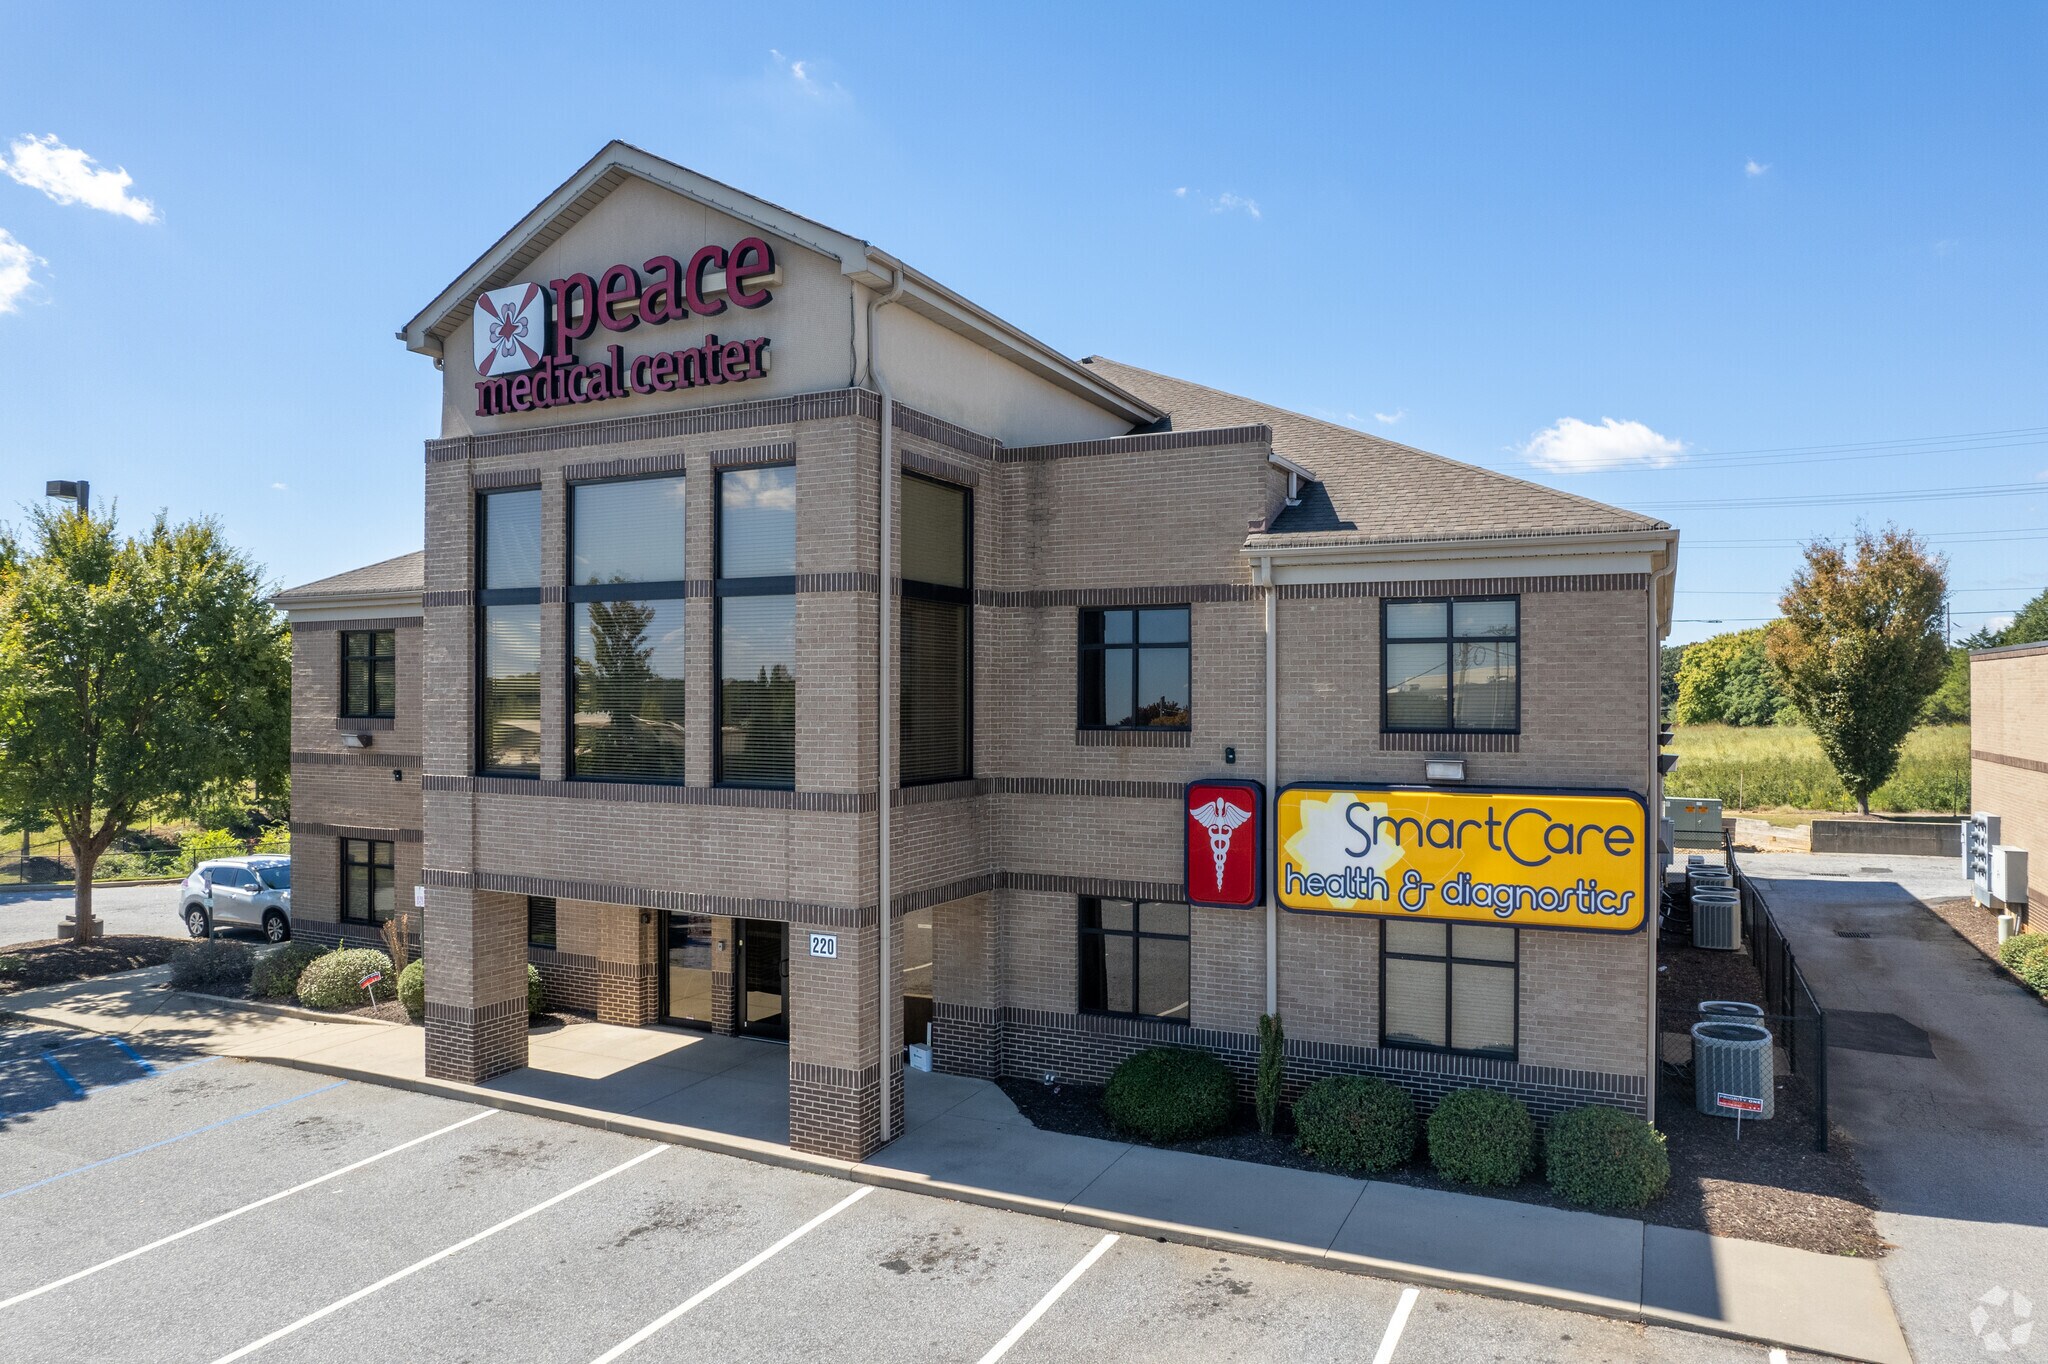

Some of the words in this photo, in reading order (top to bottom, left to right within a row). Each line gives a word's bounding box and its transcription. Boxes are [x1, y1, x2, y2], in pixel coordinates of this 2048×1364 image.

[551, 237, 774, 366] peace
[475, 345, 628, 416] medical
[630, 334, 770, 394] center
[1345, 802, 1635, 867] SmartCare
[1285, 863, 1389, 901] health
[1399, 870, 1434, 912] &
[1441, 873, 1635, 918] diagnostics
[813, 937, 834, 955] 220
